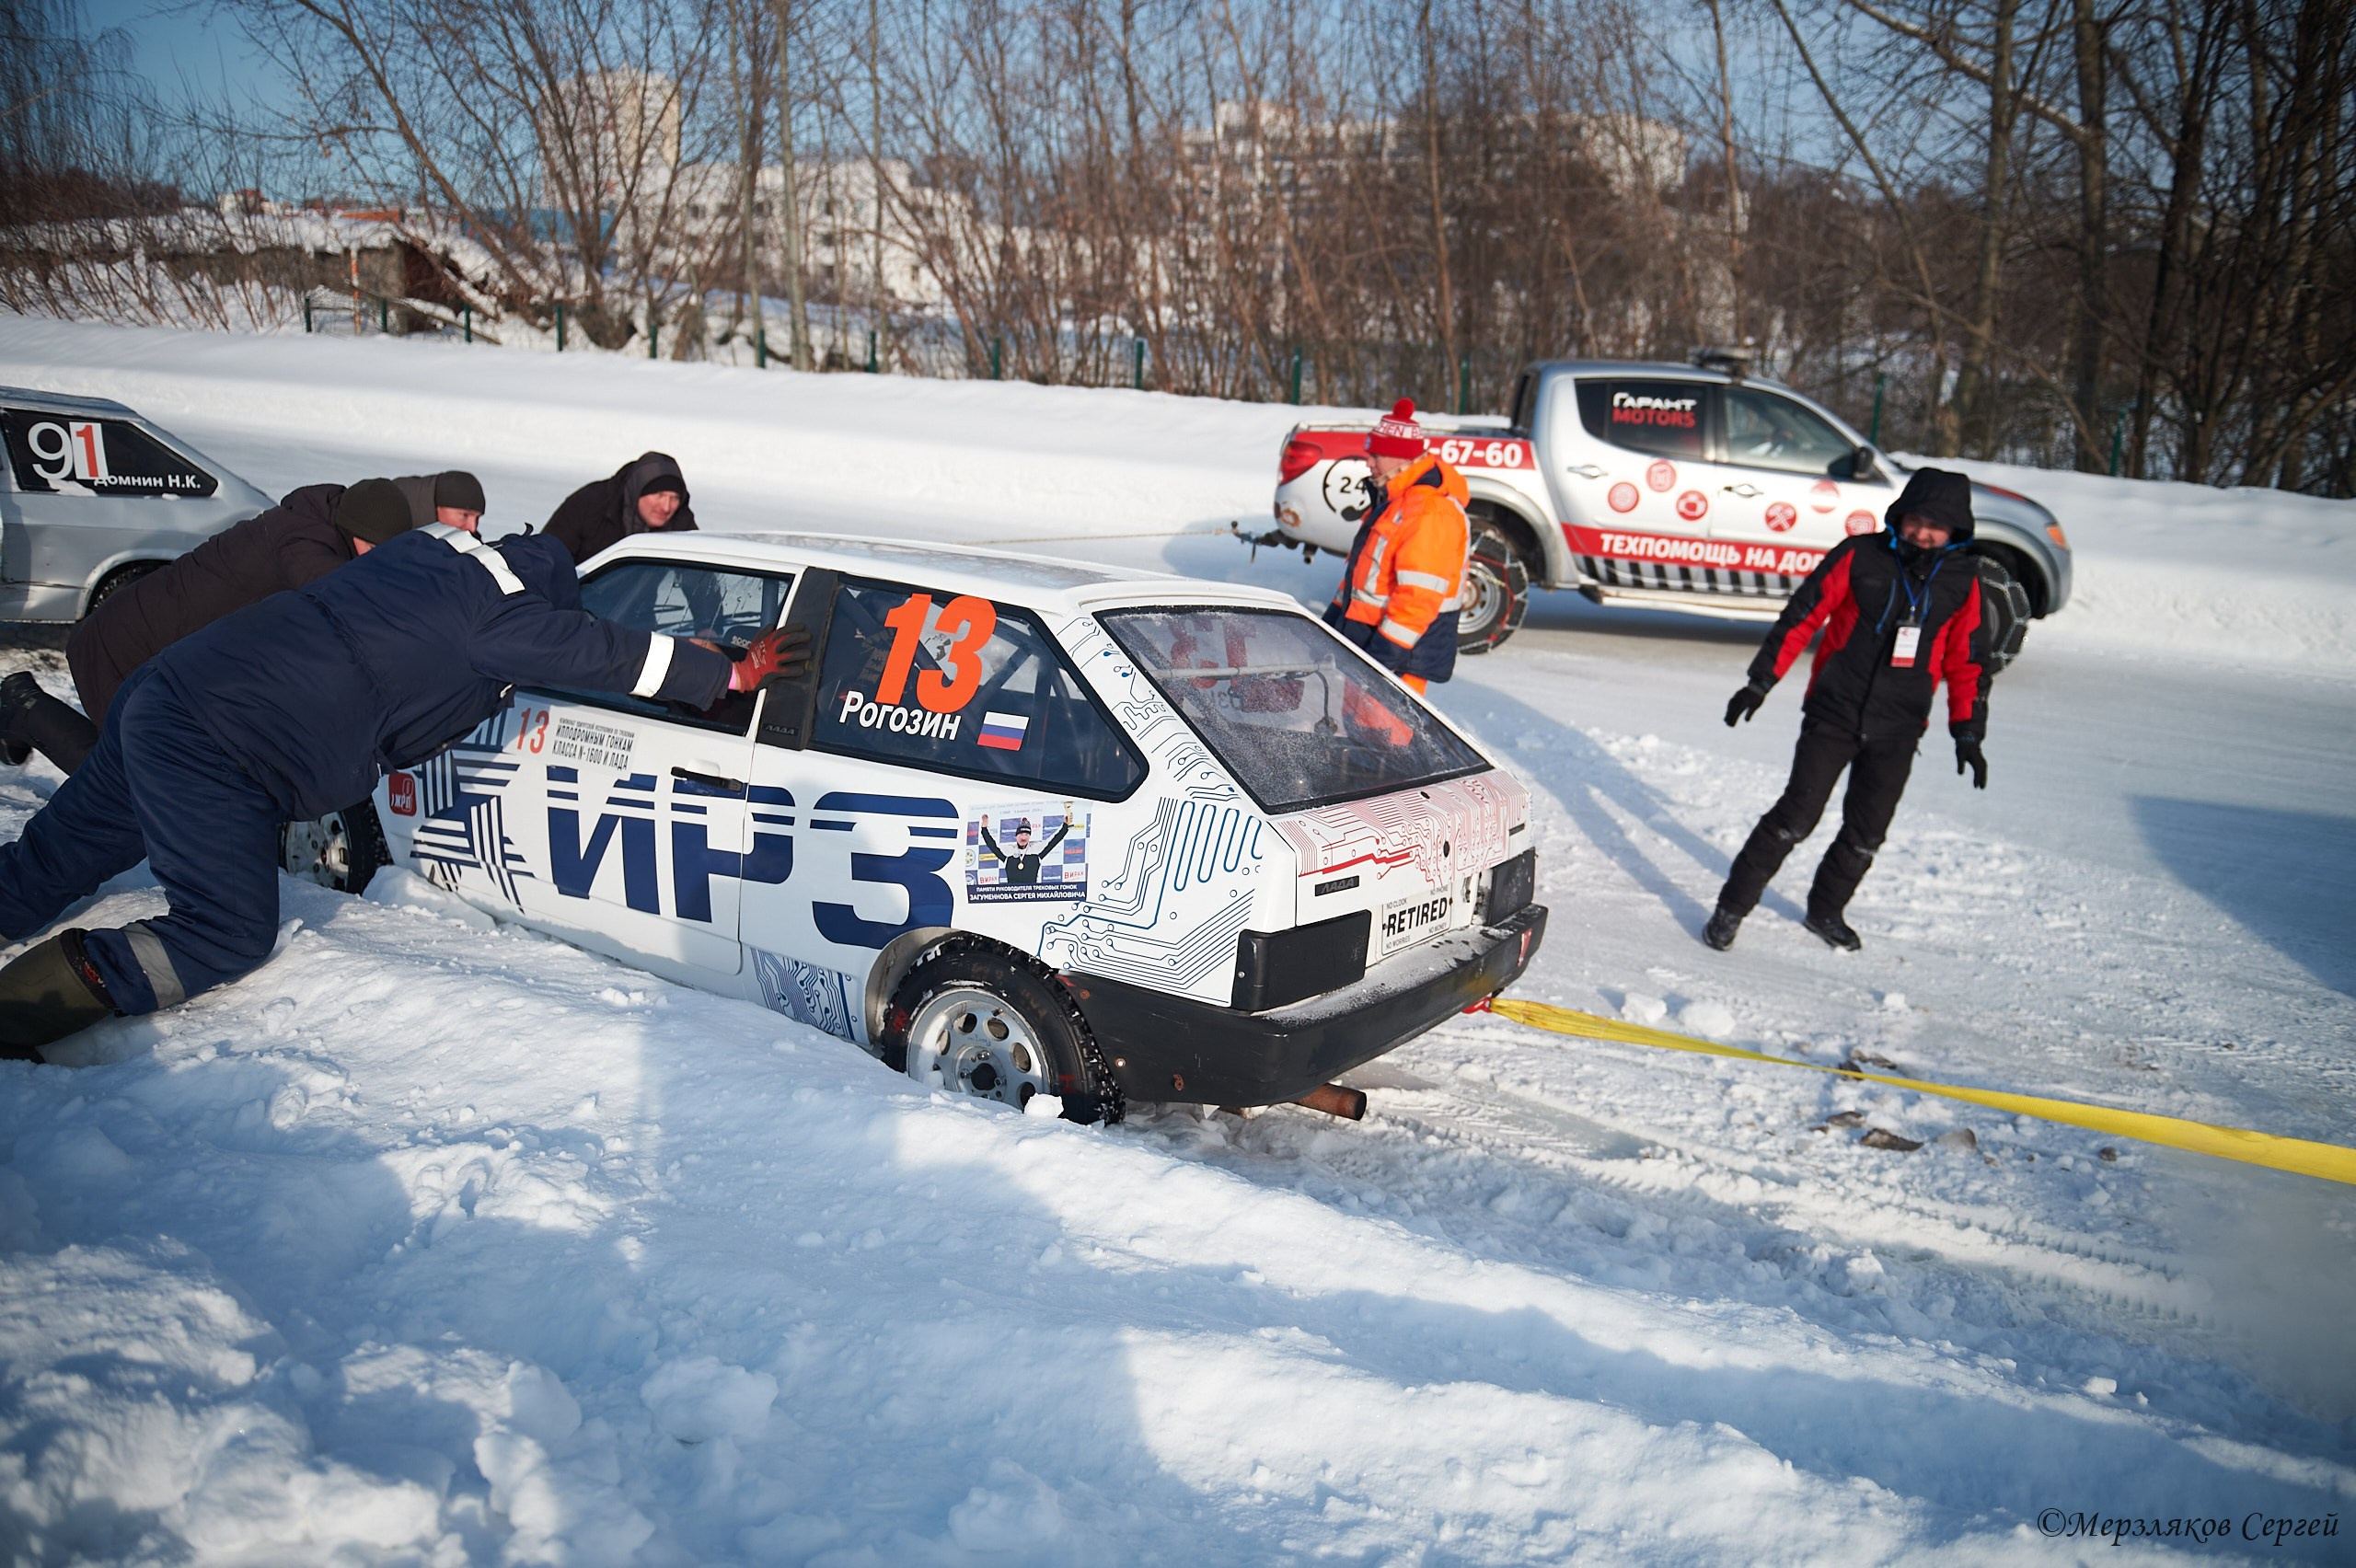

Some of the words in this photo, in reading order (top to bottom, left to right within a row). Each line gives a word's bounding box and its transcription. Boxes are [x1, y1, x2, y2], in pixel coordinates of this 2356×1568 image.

[1612, 407, 1695, 428] MOTORS
[28, 421, 101, 480] 91
[167, 474, 201, 489] Н.К.
[1340, 476, 1367, 494] 24
[1600, 534, 1740, 567] ТЕХПОМОЩЬ
[1744, 547, 1776, 569] НА
[1777, 550, 1827, 574] ДОР
[875, 593, 997, 714] 13
[517, 708, 549, 754] 13
[556, 724, 605, 746] ИППОДРОМНЫМ
[606, 734, 634, 753] ГОНКАМ
[552, 739, 578, 760] КЛАССА
[603, 751, 609, 766] И
[609, 752, 629, 771] ЛАДА
[969, 893, 1012, 901] ЗАГУМЕННОВА
[1013, 892, 1036, 900] СЕРГЕЯ
[1036, 891, 1086, 899] МИХАЙЛОВИЧА
[1321, 878, 1355, 894] ЛАДА
[1387, 896, 1448, 937] RETIRED
